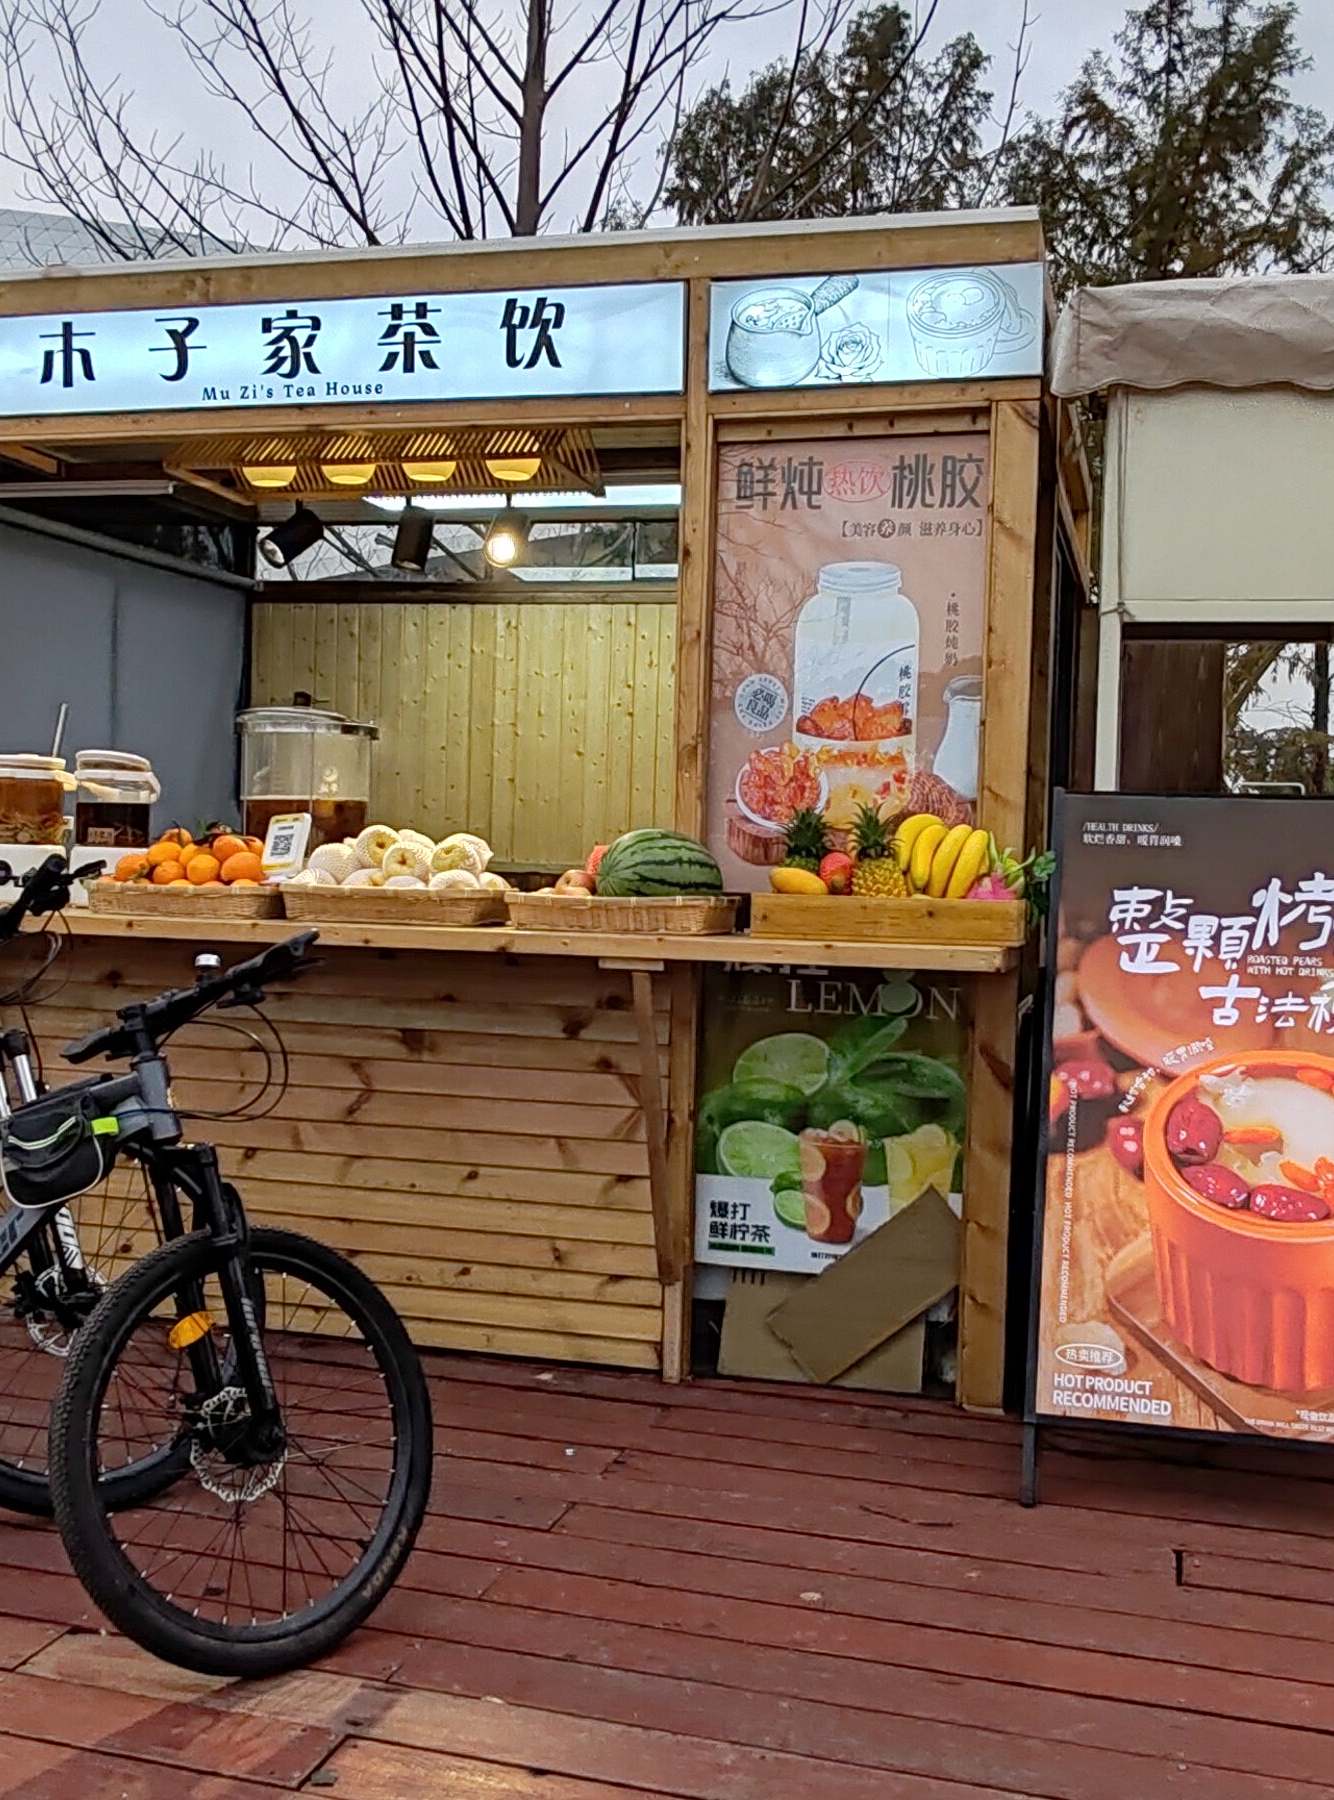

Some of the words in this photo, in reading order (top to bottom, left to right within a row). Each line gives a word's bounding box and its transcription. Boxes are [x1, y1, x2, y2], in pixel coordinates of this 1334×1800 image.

[39, 297, 565, 388] 木子家茶饮
[202, 386, 231, 401] Mu
[240, 383, 274, 400] Zi's
[283, 382, 316, 399] Tea
[326, 380, 384, 397] House
[828, 467, 885, 496] 热饮
[891, 453, 984, 509] 桃胶
[1246, 955, 1288, 966] ROASTED
[1292, 956, 1323, 967] PEARS
[1246, 966, 1271, 975] WITH
[1275, 967, 1294, 976] HOT
[1298, 968, 1334, 977] DRINKS
[1067, 1099, 1078, 1136] PRODUCT
[1064, 1137, 1076, 1199] RECOMMENDED
[710, 1200, 751, 1221] 爆打
[1063, 1201, 1074, 1218] HOT
[709, 1220, 771, 1244] 鲜柠茶
[1062, 1220, 1073, 1258] PRODUCT
[1058, 1260, 1071, 1323] RECOMMENDED
[1053, 1372, 1085, 1390] HOT
[1085, 1376, 1154, 1396] PRODUCT
[1053, 1389, 1172, 1416] RECOMMENDED
